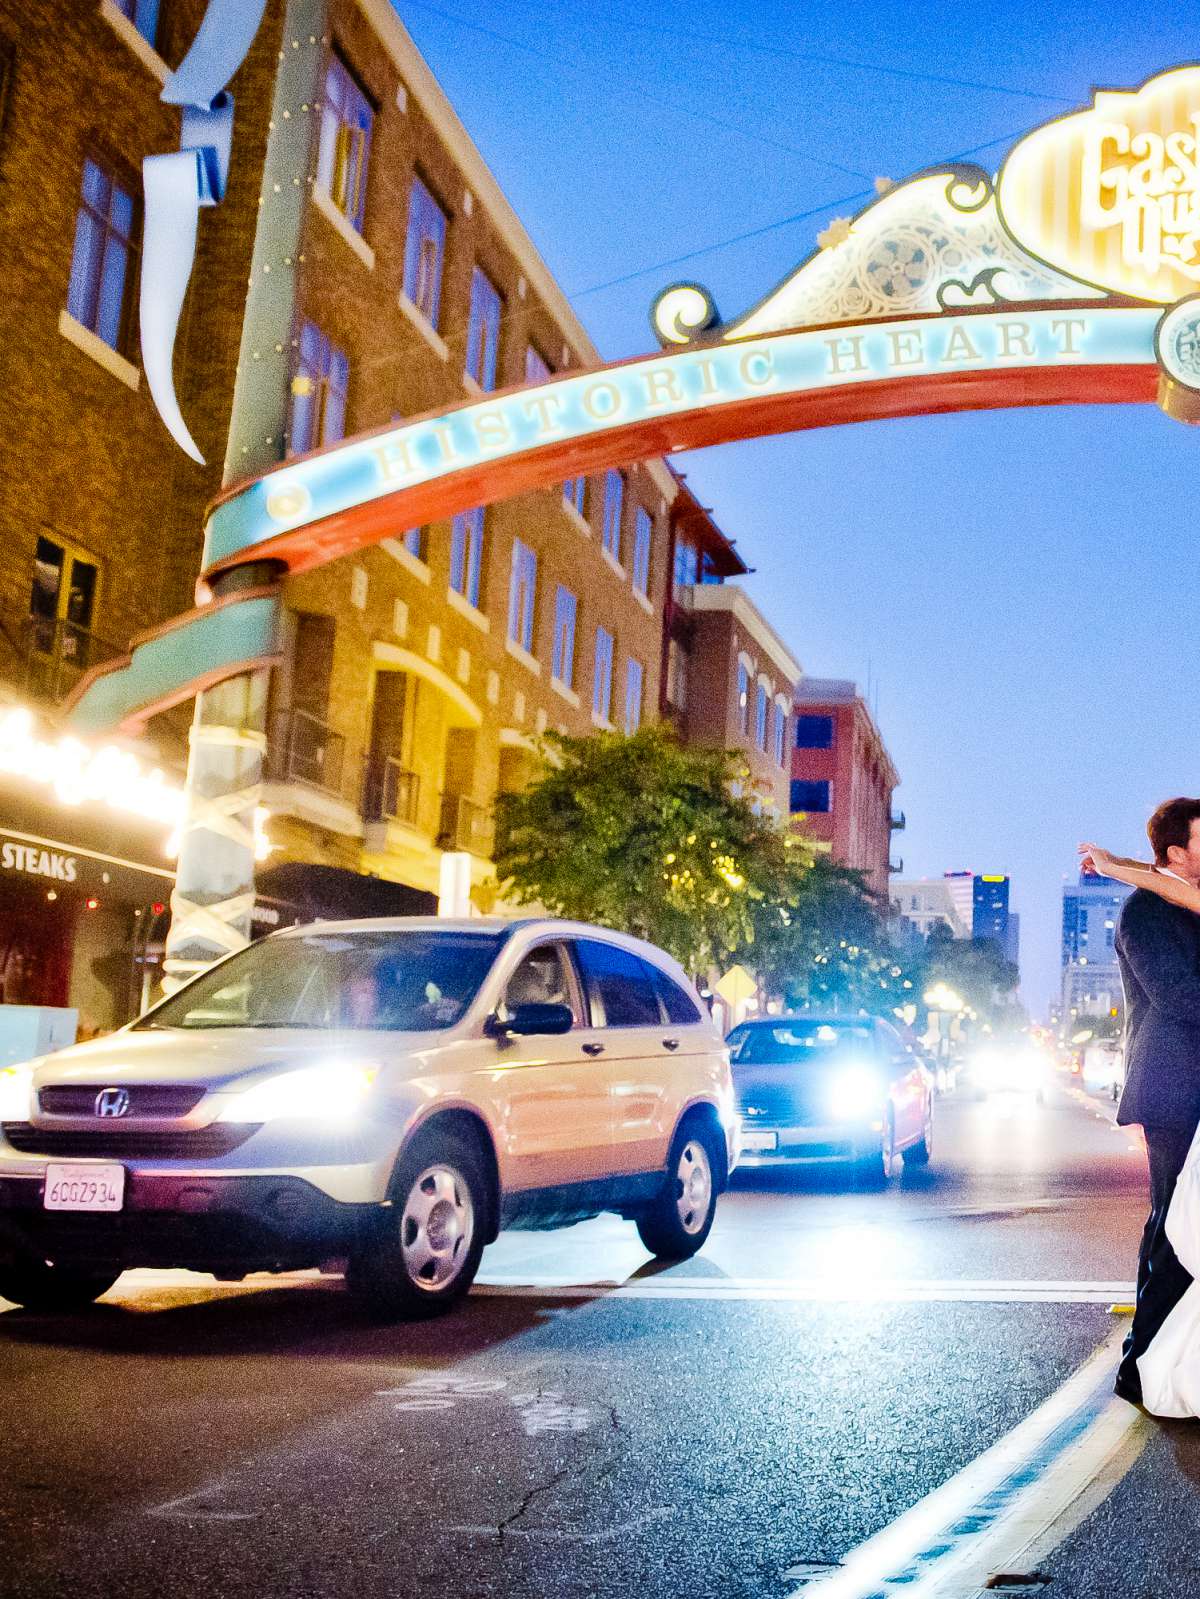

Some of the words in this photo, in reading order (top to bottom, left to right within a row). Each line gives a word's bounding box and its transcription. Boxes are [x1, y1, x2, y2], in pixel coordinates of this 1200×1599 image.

[373, 348, 776, 482] HISTORIC
[824, 318, 1087, 375] HEART
[1, 842, 77, 882] STEAKS
